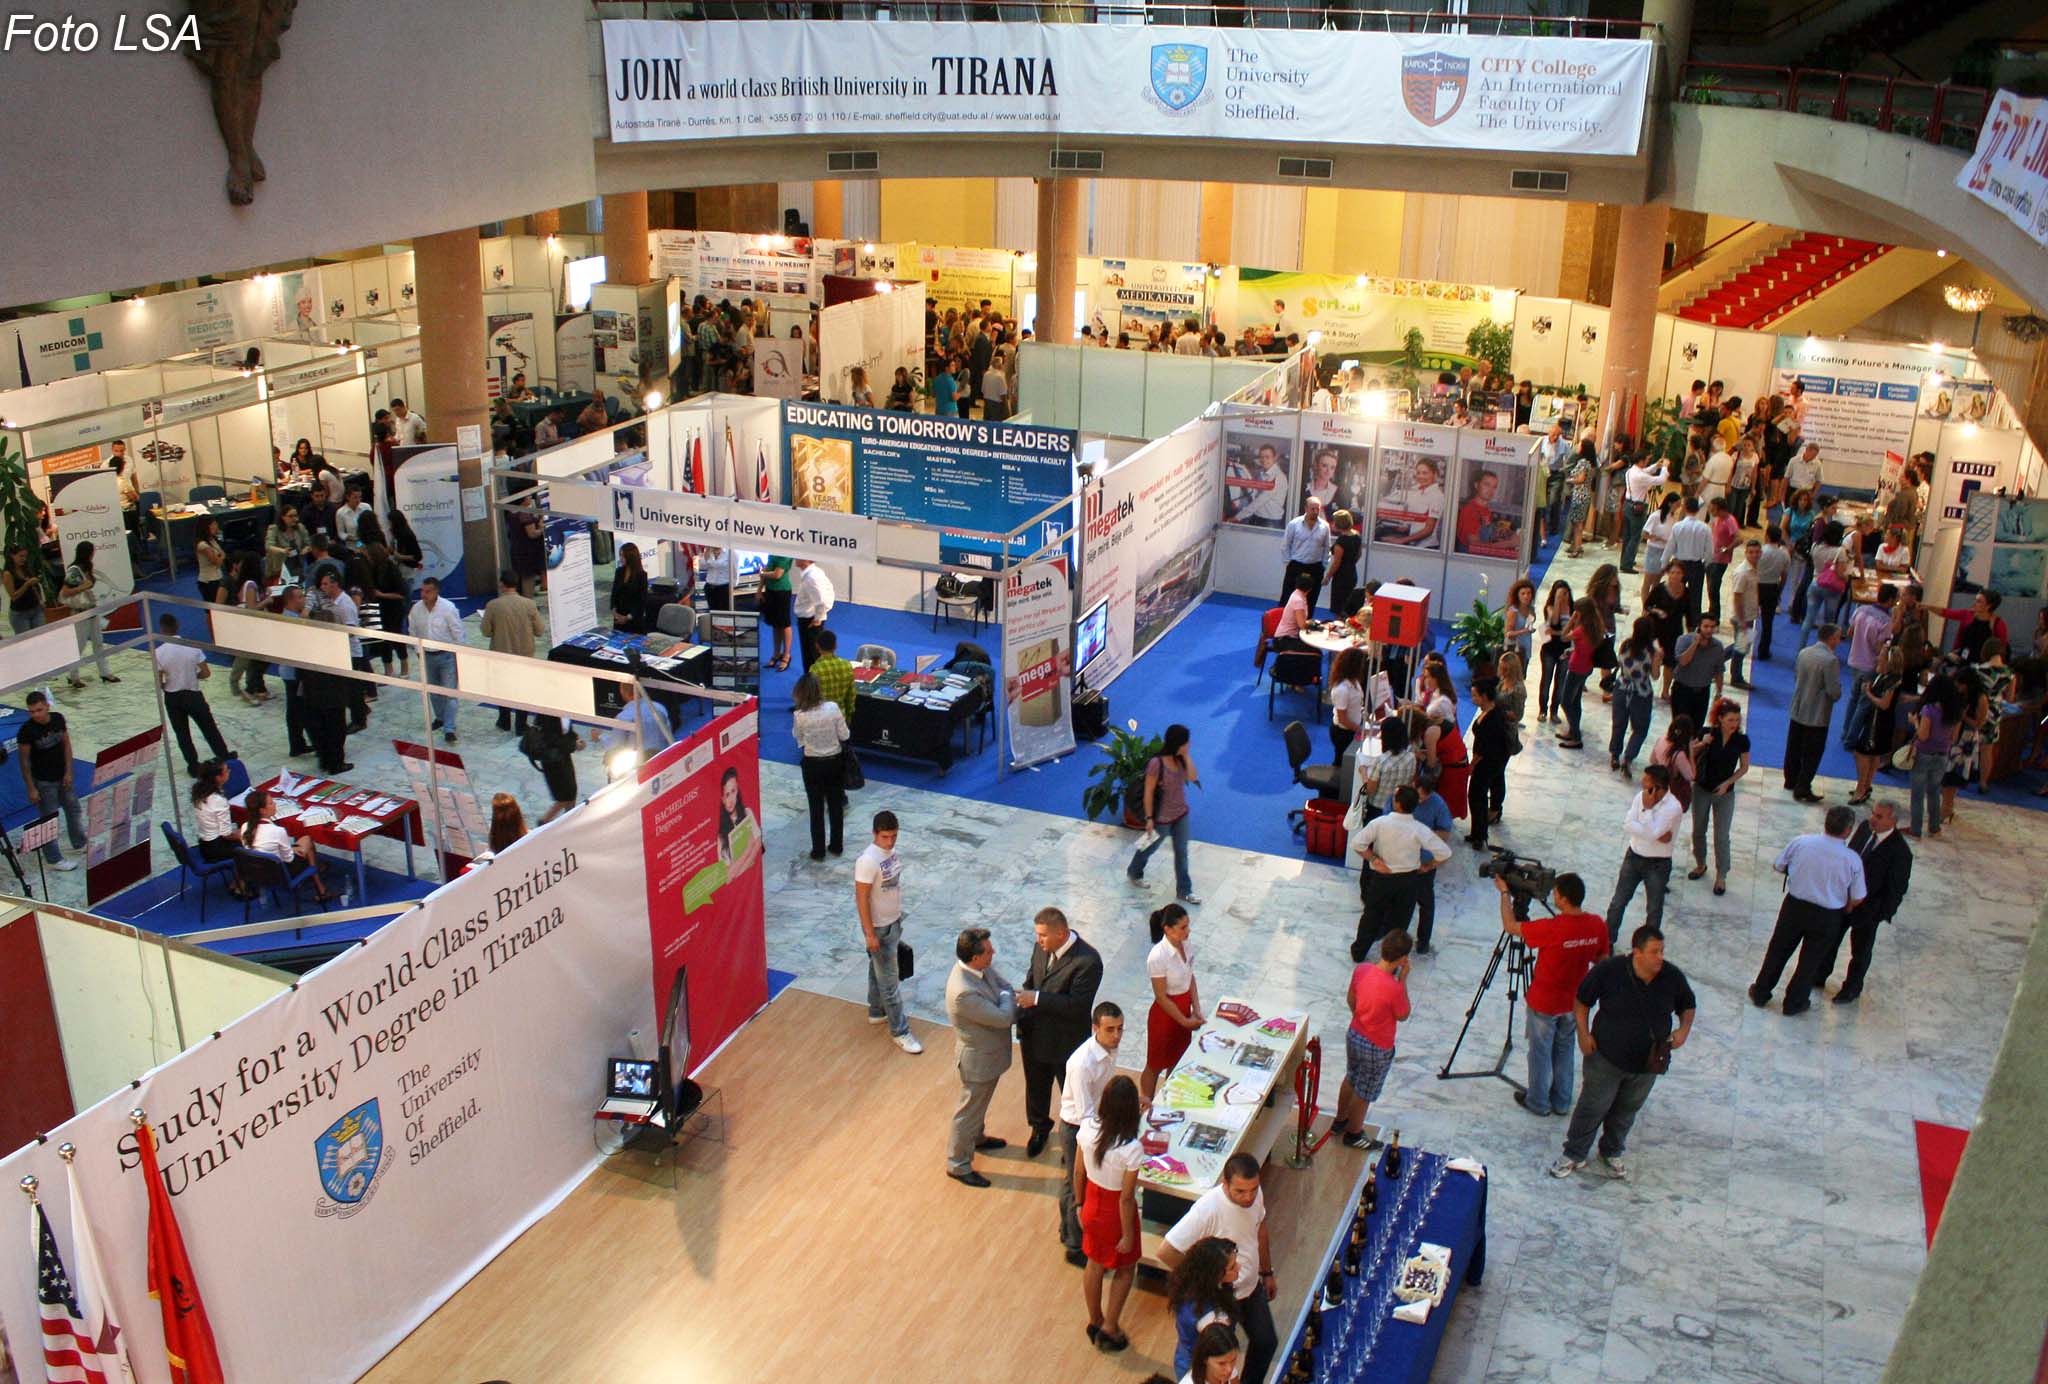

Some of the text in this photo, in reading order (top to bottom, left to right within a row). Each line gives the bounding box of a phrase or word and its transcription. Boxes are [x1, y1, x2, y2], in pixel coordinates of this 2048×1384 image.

[1226, 48, 1259, 63] The
[615, 57, 1059, 101] JOIN a world class British University in TIRANA
[1226, 67, 1309, 88] University
[1481, 57, 1526, 74] CITY
[1531, 58, 1597, 79] College
[1225, 85, 1246, 100] Of
[1480, 76, 1623, 96] An International
[831, 111, 846, 120] 110
[1224, 103, 1300, 121] Sheffield.
[1478, 95, 1567, 115] Faculty Of
[1476, 114, 1603, 136] The University.
[1120, 290, 1192, 304] MEDIKADENT
[39, 337, 86, 353] MEDICOM
[1811, 355, 1849, 366] Creating
[1852, 359, 1889, 369] Future's
[787, 406, 873, 431] EDUCATING
[992, 430, 1071, 453] LEADERS
[861, 437, 909, 449] EURO-AMERICAN
[909, 441, 942, 452] EDUCATION
[992, 452, 1039, 464] INTERNATIONAL
[1040, 456, 1066, 466] FACULTY
[813, 476, 826, 493] 8
[640, 506, 858, 550] University of New York Tirana
[1086, 491, 1135, 545] megatek
[1008, 577, 1053, 598] megatek
[1019, 661, 1051, 687] mega
[235, 1044, 286, 1096] for
[297, 1031, 314, 1057] a
[320, 905, 490, 1036] World-Class
[494, 846, 579, 922] British
[158, 1059, 343, 1198] University
[348, 984, 447, 1074] Degree
[452, 965, 480, 1001] in
[482, 903, 564, 976] Tirana
[398, 1061, 431, 1096] The
[400, 1047, 483, 1119] University
[405, 1114, 425, 1143] Of
[410, 1097, 482, 1167] Sheffield.
